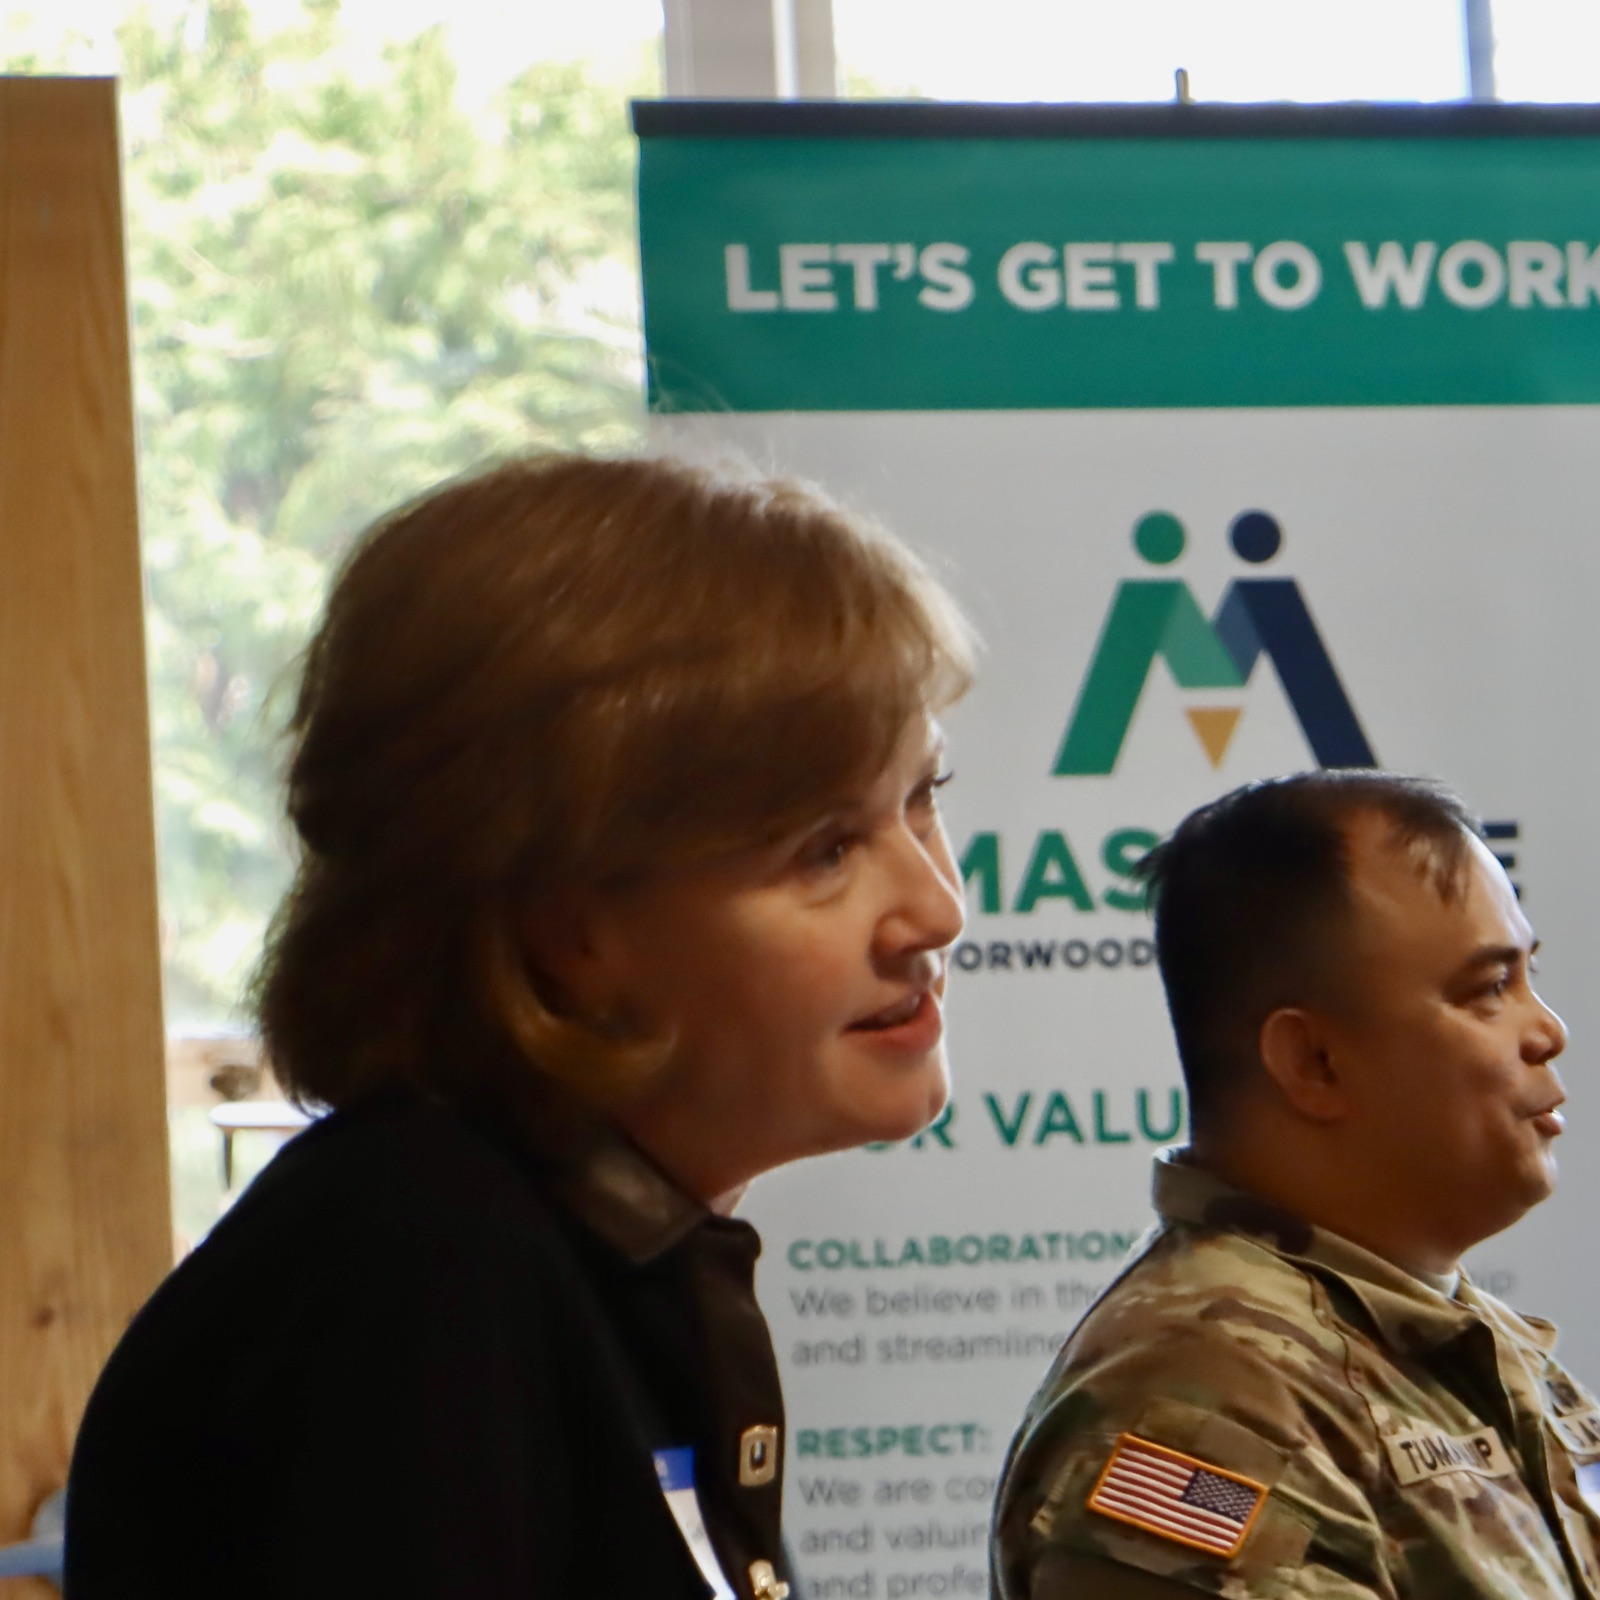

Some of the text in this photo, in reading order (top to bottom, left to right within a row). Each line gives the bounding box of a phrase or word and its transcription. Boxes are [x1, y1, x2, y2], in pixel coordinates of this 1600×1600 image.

[724, 241, 975, 312] LET'S
[998, 241, 1175, 312] GET
[1196, 241, 1323, 311] TO
[952, 938, 1157, 971] ORWOOD
[790, 1285, 855, 1318] We
[866, 1281, 998, 1317] believe
[1010, 1280, 1042, 1312] in
[791, 1329, 865, 1366] and
[796, 1422, 992, 1459] RESPECT:
[798, 1475, 861, 1506] We
[874, 1477, 936, 1505] are
[801, 1522, 869, 1555] and
